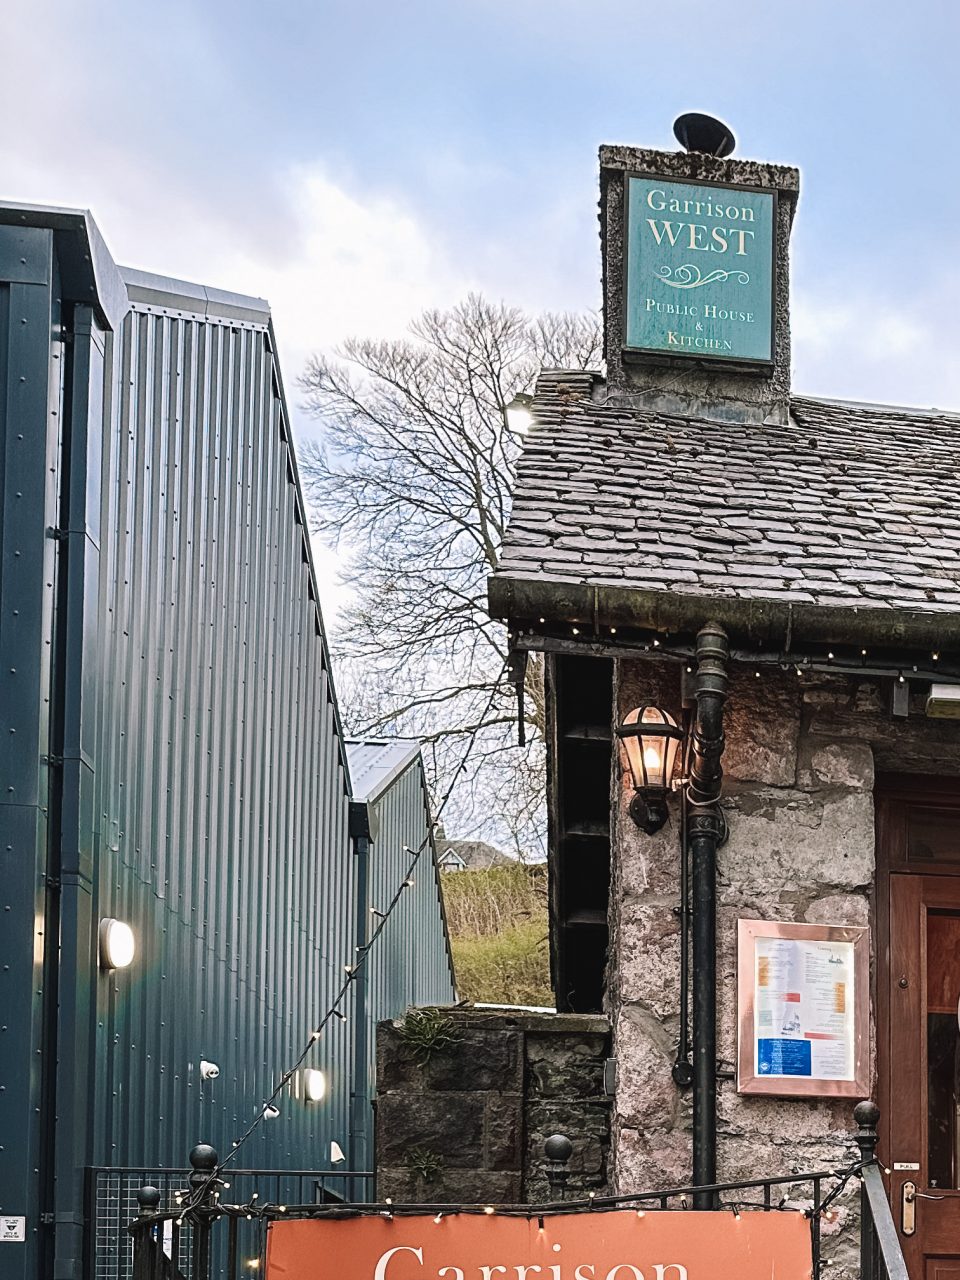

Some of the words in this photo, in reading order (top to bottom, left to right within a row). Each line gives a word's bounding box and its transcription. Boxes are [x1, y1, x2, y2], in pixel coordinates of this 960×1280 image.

[647, 189, 755, 222] Garrison
[646, 219, 755, 256] WEST
[646, 298, 698, 317] PUBLIC
[704, 305, 755, 323] HOUSE
[695, 322, 704, 331] &
[667, 331, 732, 350] KITCHEN
